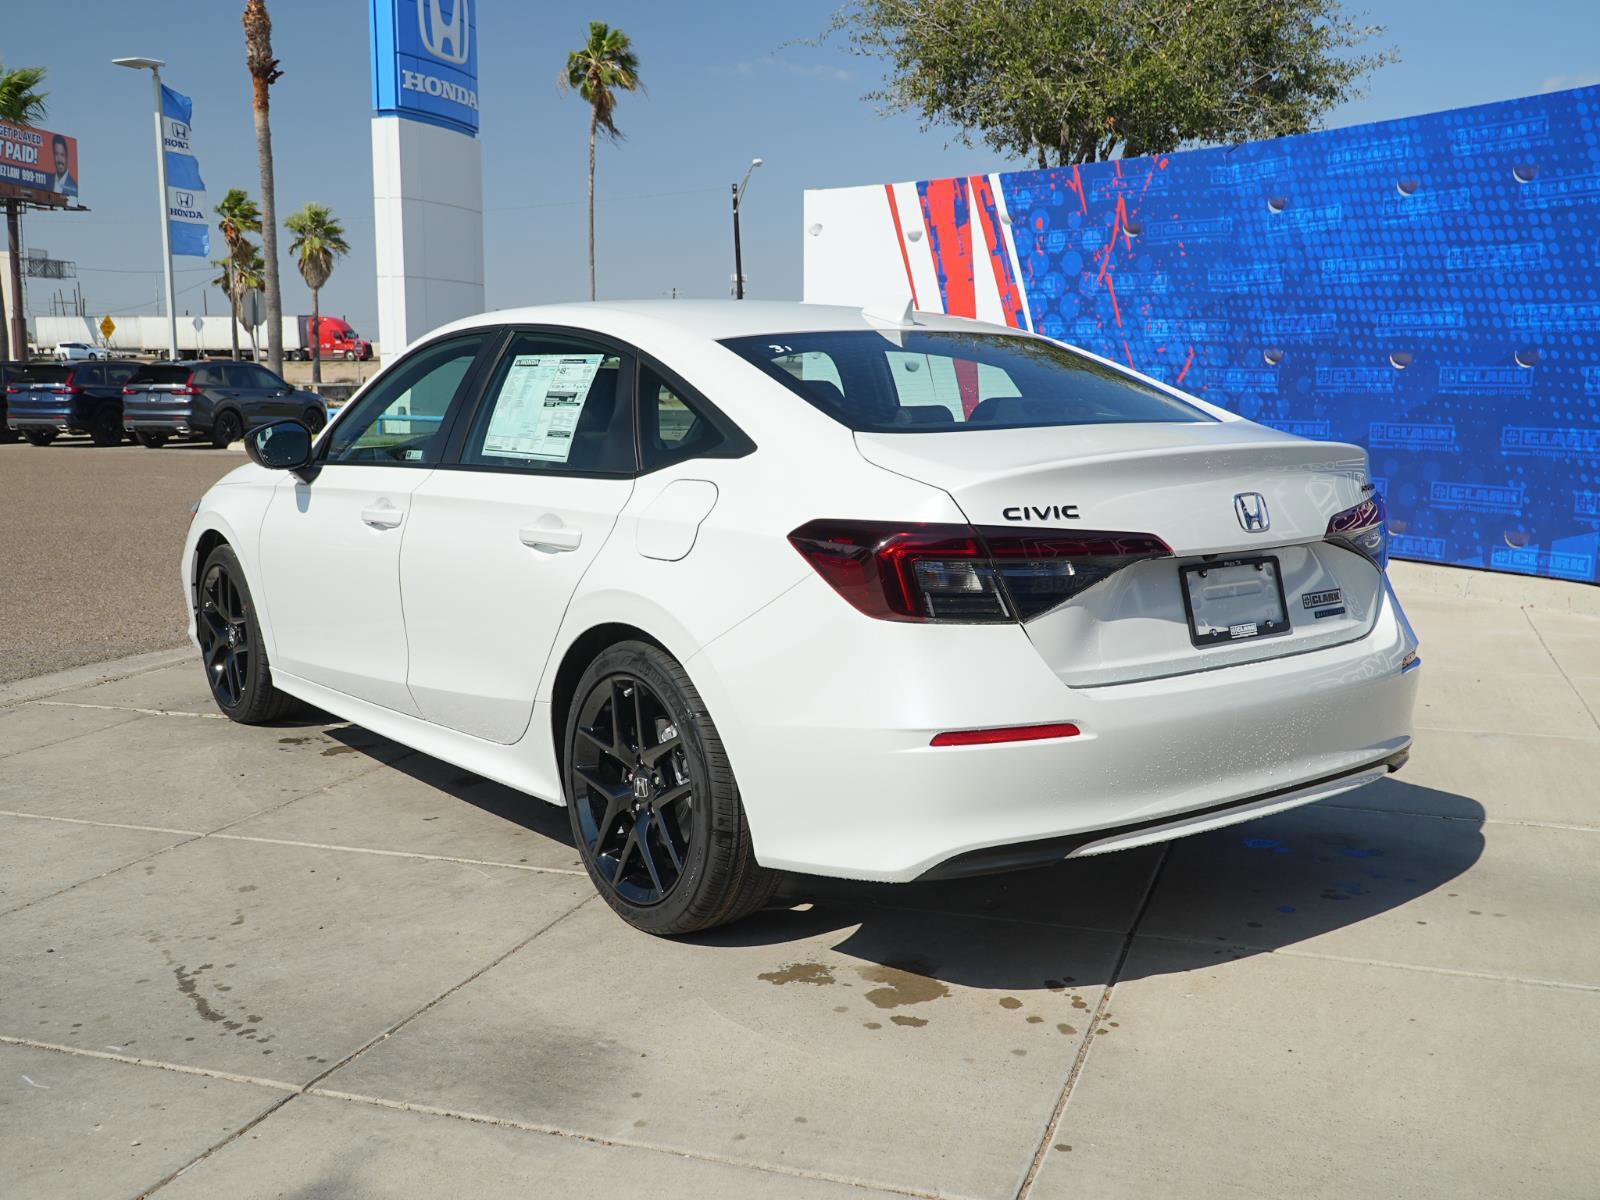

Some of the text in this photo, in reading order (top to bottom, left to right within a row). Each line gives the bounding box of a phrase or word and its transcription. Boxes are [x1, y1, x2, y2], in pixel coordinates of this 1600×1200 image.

[402, 69, 479, 112] HONDA
[13, 128, 42, 146] PLAYED
[5, 141, 38, 164] PAID!
[170, 207, 204, 219] HONDA
[1450, 486, 1519, 504] CLARK
[1003, 505, 1081, 521] CIVIC
[1312, 592, 1340, 605] CLARK
